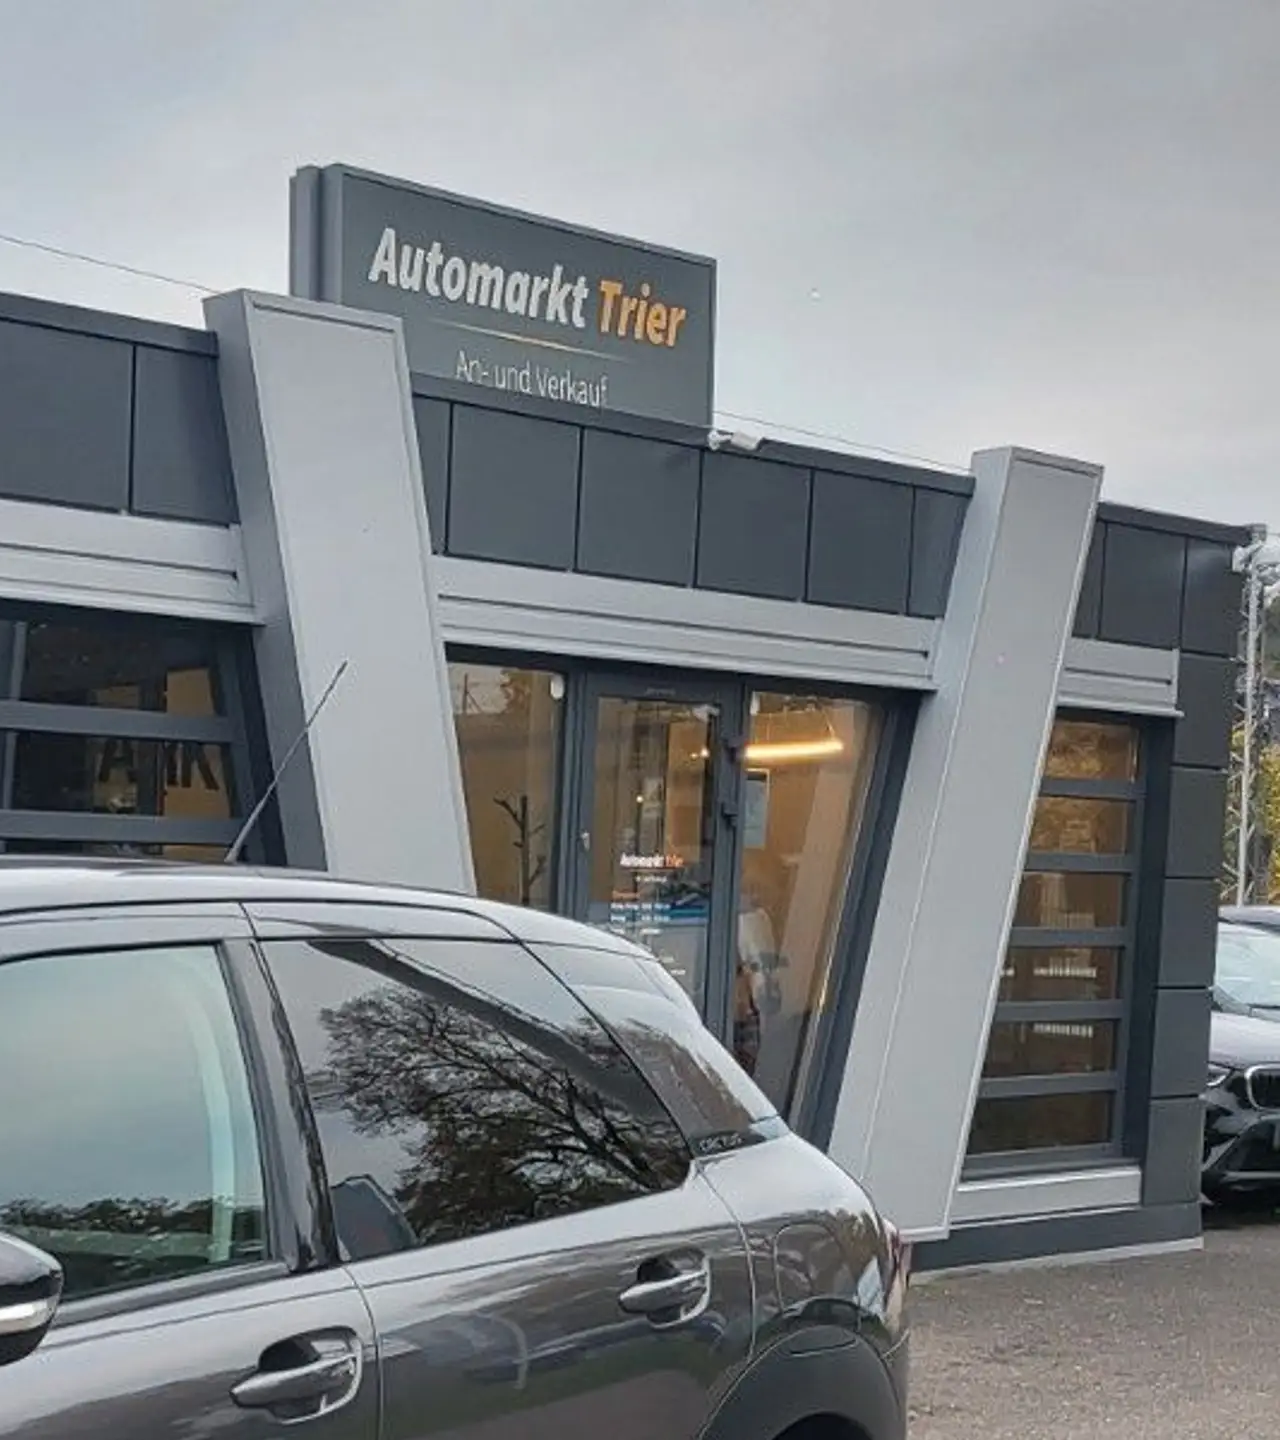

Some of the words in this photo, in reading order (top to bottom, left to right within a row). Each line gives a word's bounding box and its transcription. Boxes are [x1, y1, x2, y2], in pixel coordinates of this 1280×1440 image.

[368, 228, 589, 327] Automarkt
[599, 281, 687, 346] Trier
[494, 361, 532, 393] und
[535, 368, 609, 409] Verkauf
